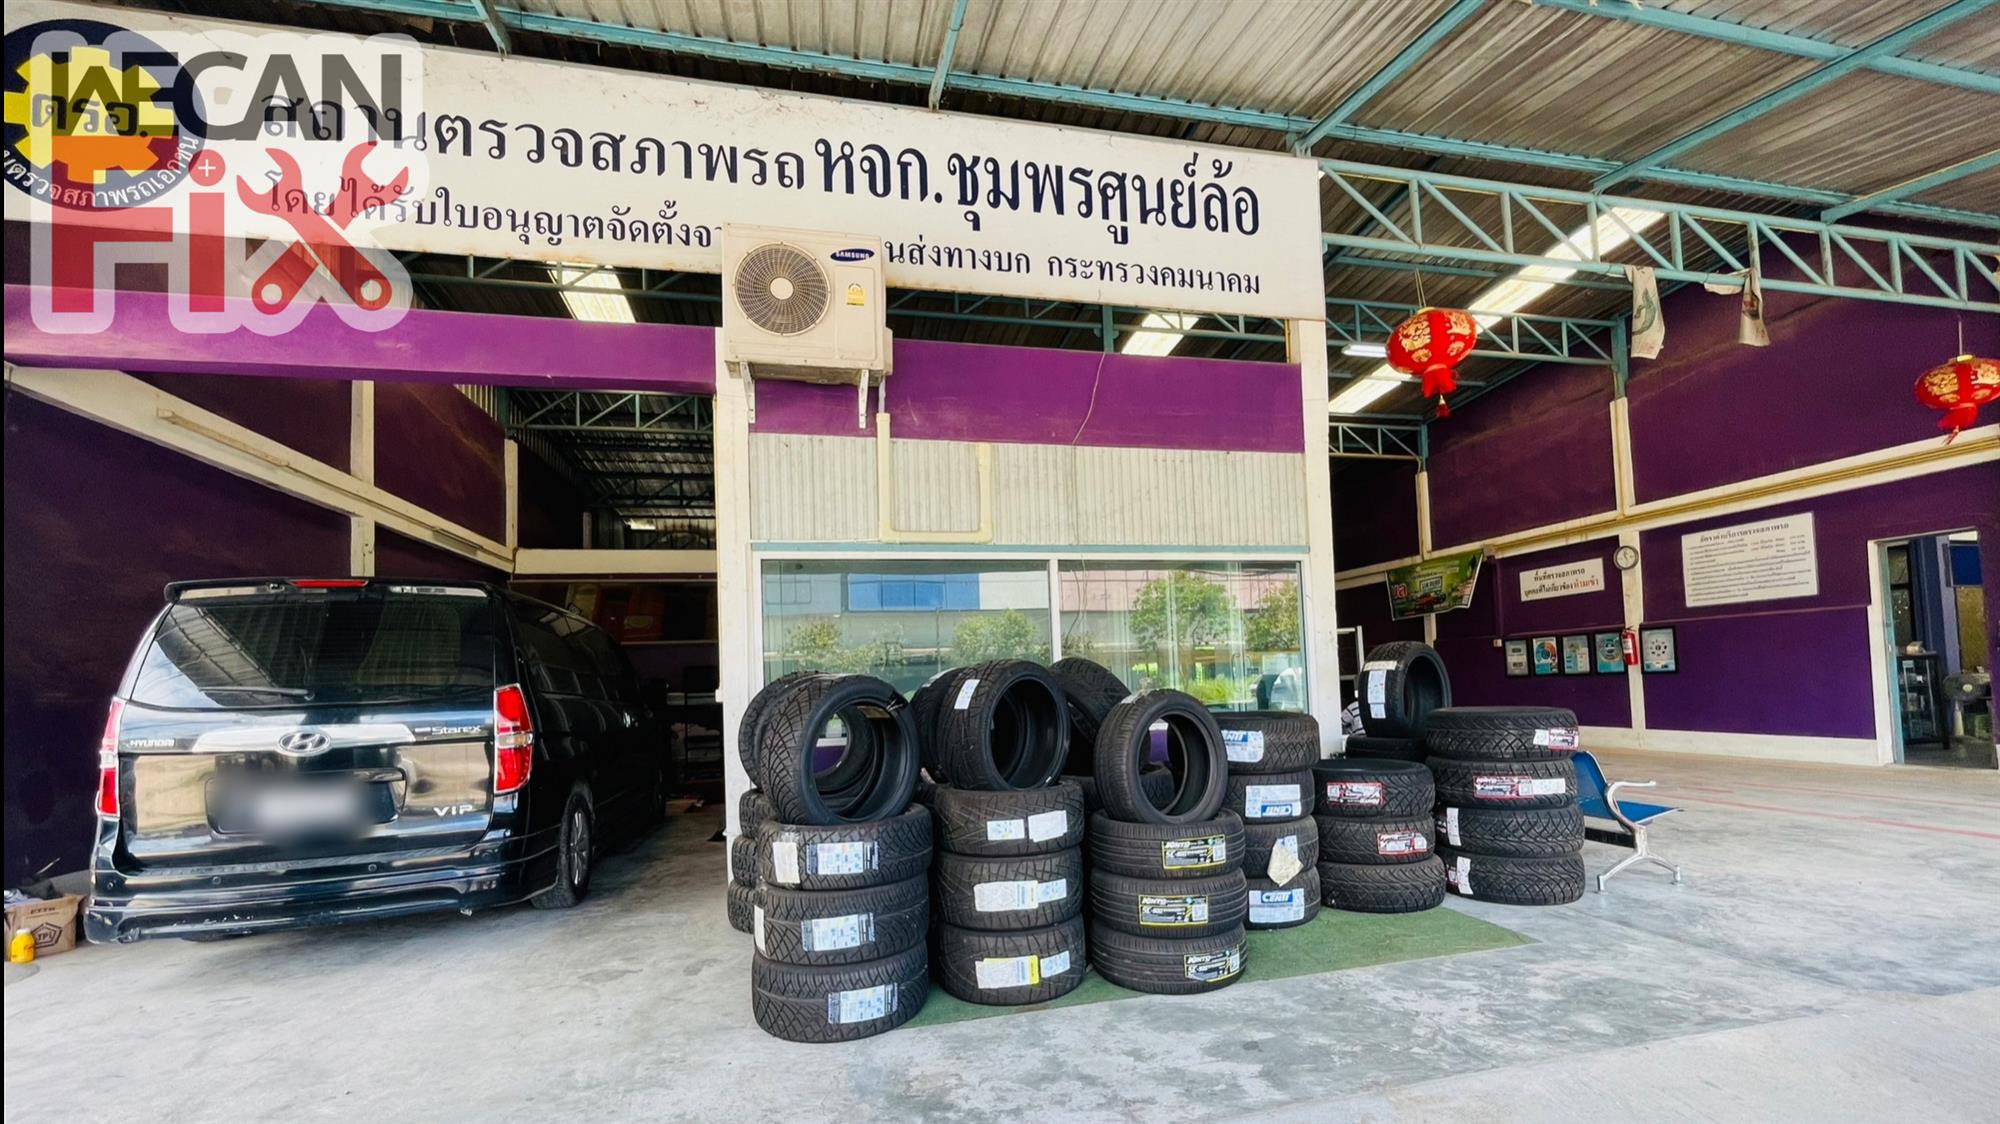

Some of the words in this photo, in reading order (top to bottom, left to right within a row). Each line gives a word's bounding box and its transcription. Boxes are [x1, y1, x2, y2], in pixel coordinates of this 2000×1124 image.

[261, 95, 804, 189] สถานตรวจสภาพรถ
[814, 137, 1259, 244] หจก.ชุมพรศูนย์ล้อ
[884, 234, 1030, 274] นส่งทางบก
[1048, 255, 1260, 294] กระทรวงคมนาคม
[433, 804, 473, 816] VIP
